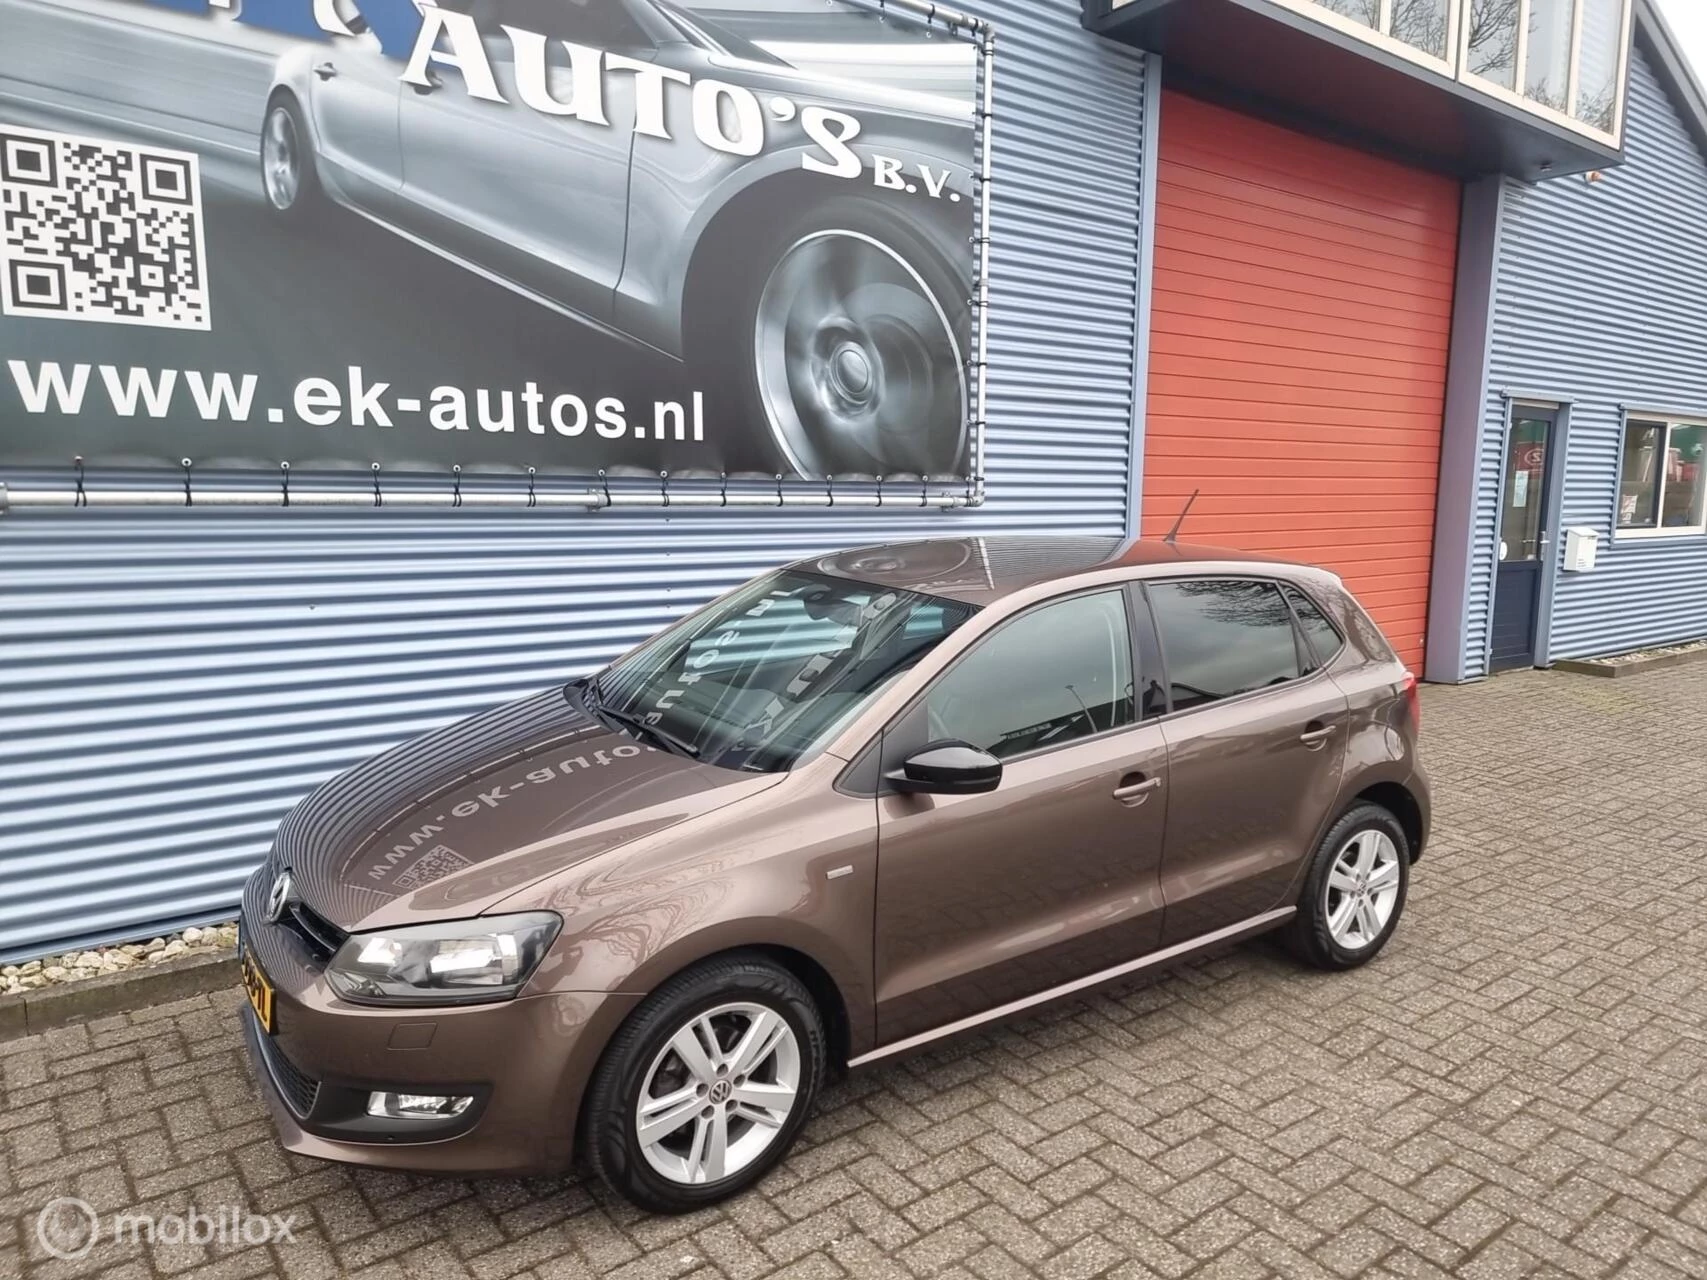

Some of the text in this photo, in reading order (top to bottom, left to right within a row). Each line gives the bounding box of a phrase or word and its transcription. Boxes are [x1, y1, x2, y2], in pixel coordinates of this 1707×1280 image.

[402, 3, 962, 202] AUTO'S B.V.
[8, 359, 705, 443] www.ek-autos.nl
